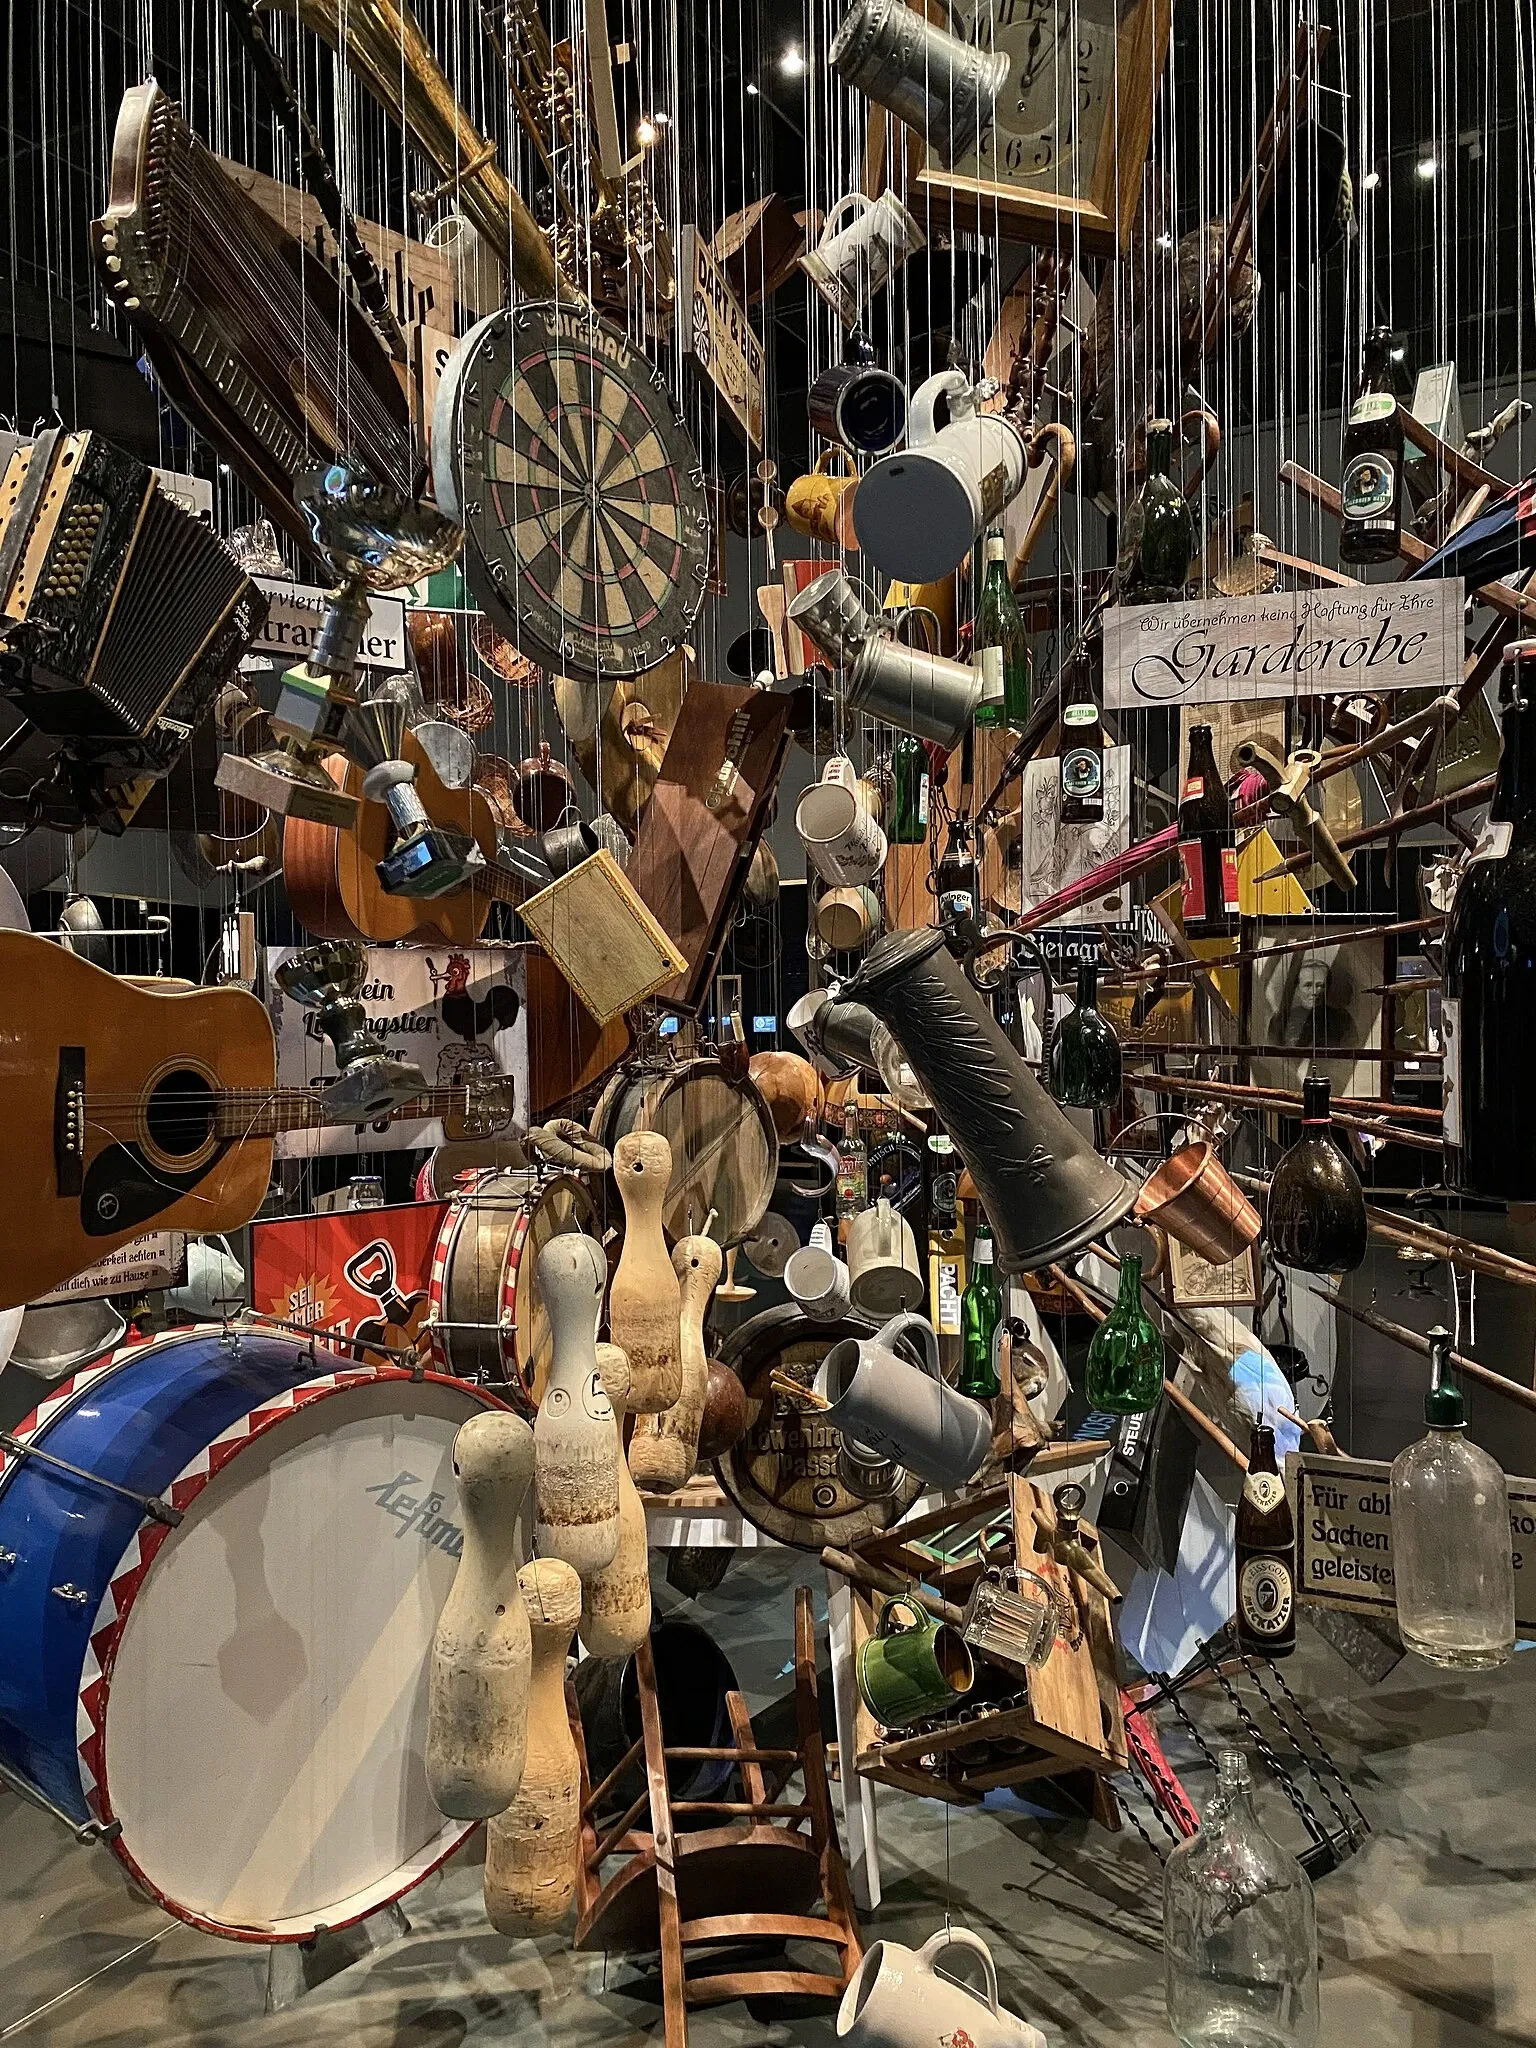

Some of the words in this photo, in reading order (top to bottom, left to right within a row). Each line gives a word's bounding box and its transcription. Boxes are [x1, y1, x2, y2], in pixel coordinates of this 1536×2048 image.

[1005, 138, 1022, 170] 6
[1034, 134, 1053, 166] 5
[699, 250, 729, 326] DART
[1140, 616, 1169, 632] Wir
[1172, 609, 1256, 630] übernehmen
[1259, 607, 1297, 624] keine
[1300, 601, 1368, 621] Haftung
[1370, 599, 1396, 618] für
[1398, 595, 1435, 611] Ihre
[1130, 615, 1429, 701] Garderobe
[361, 978, 395, 1001] ein
[71, 1273, 91, 1292] dich
[92, 1273, 109, 1288] wie
[110, 1273, 122, 1286] zu
[123, 1268, 150, 1284] Hause
[940, 1263, 958, 1325] PACHT
[288, 1283, 312, 1313] SEI
[1122, 1412, 1144, 1457] STEUE
[1311, 1483, 1349, 1510] Für
[1311, 1518, 1389, 1550] Sachen
[1243, 1594, 1291, 1630] MECKATZER
